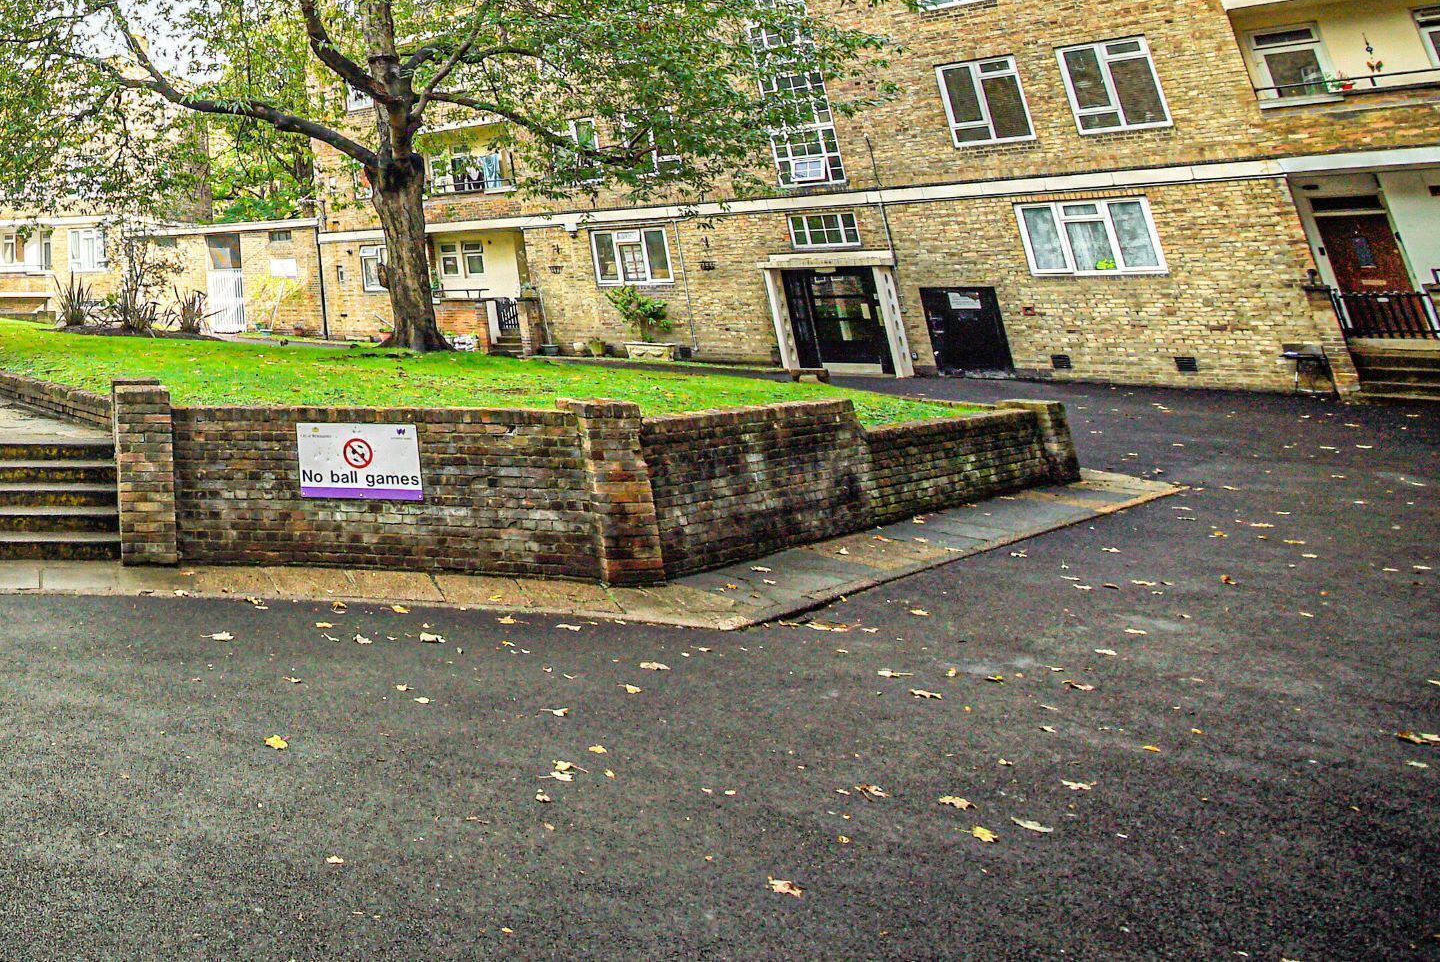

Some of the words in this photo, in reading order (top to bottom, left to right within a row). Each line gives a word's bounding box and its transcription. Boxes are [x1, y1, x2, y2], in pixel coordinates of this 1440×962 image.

[302, 469, 323, 483] No
[330, 470, 358, 484] ball
[365, 475, 419, 487] games
